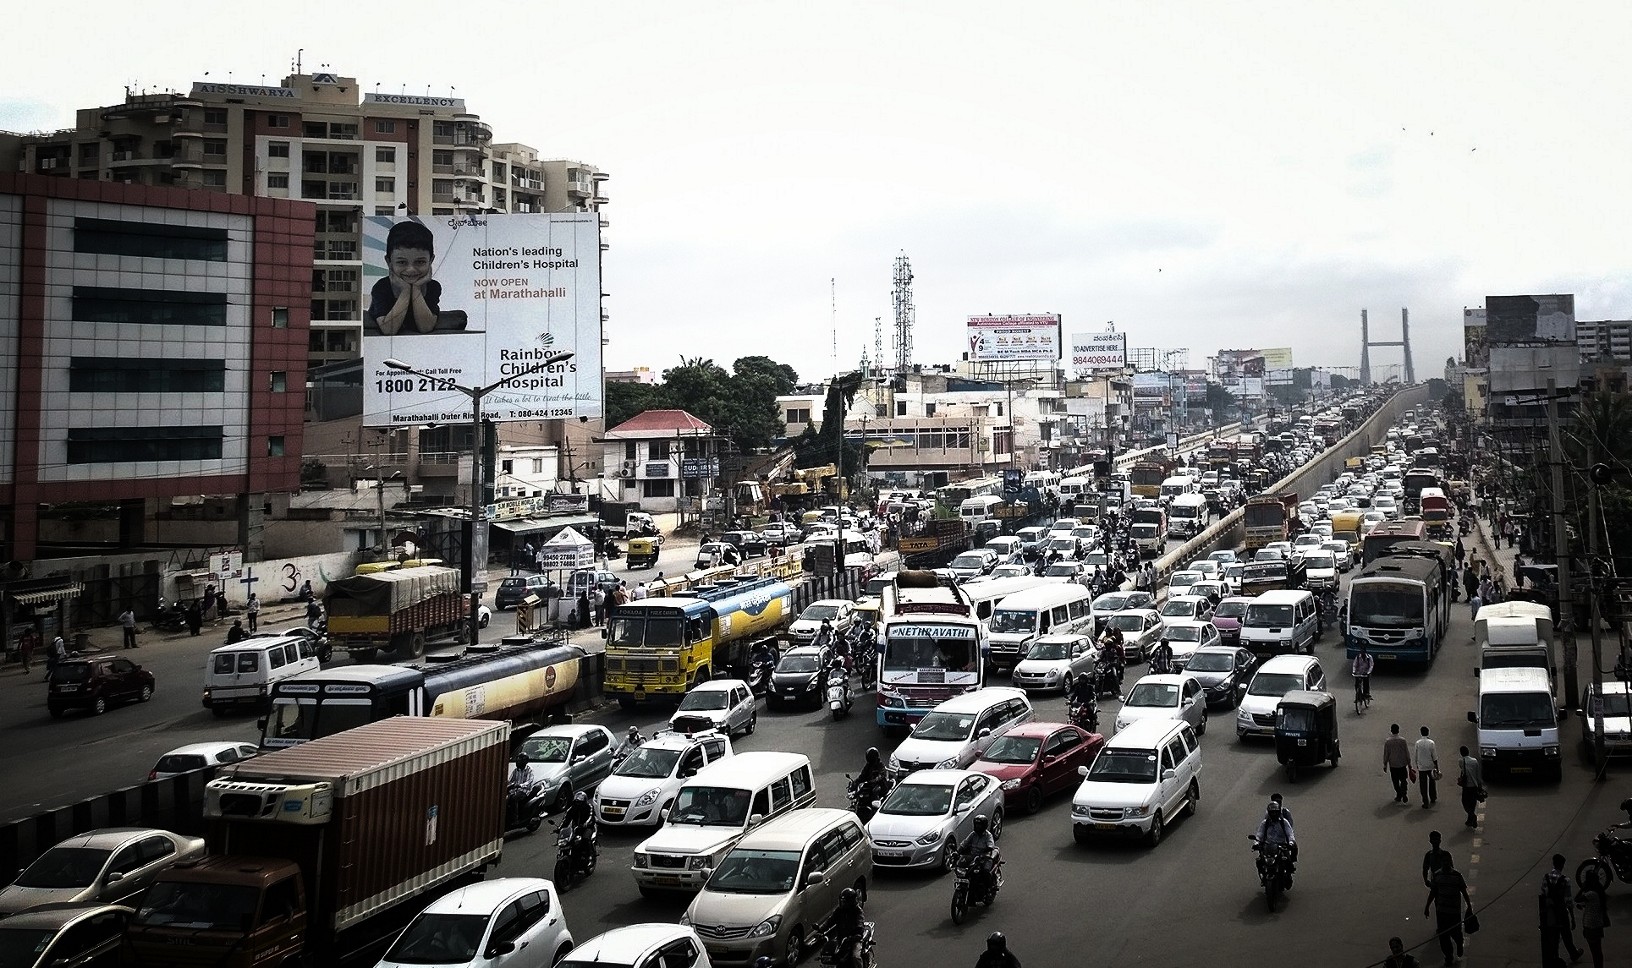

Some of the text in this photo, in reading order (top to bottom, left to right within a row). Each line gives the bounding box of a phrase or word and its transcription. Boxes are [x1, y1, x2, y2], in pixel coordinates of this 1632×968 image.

[200, 84, 295, 98] AISSHWARYA
[374, 94, 455, 107] EXCELLENCY
[472, 246, 563, 258] Nation's leading
[472, 259, 579, 270] Children's Hospital
[473, 278, 529, 287] NOW OPEN
[474, 287, 566, 299] at Marathahalli
[1072, 355, 1123, 365] 9844069444
[375, 377, 456, 393] 1800 2122
[500, 374, 564, 390] Hospital
[392, 414, 439, 423] Marathahalli
[440, 413, 461, 421] Outer
[462, 412, 475, 420] Rin
[509, 408, 573, 418] T: 080-424 12345
